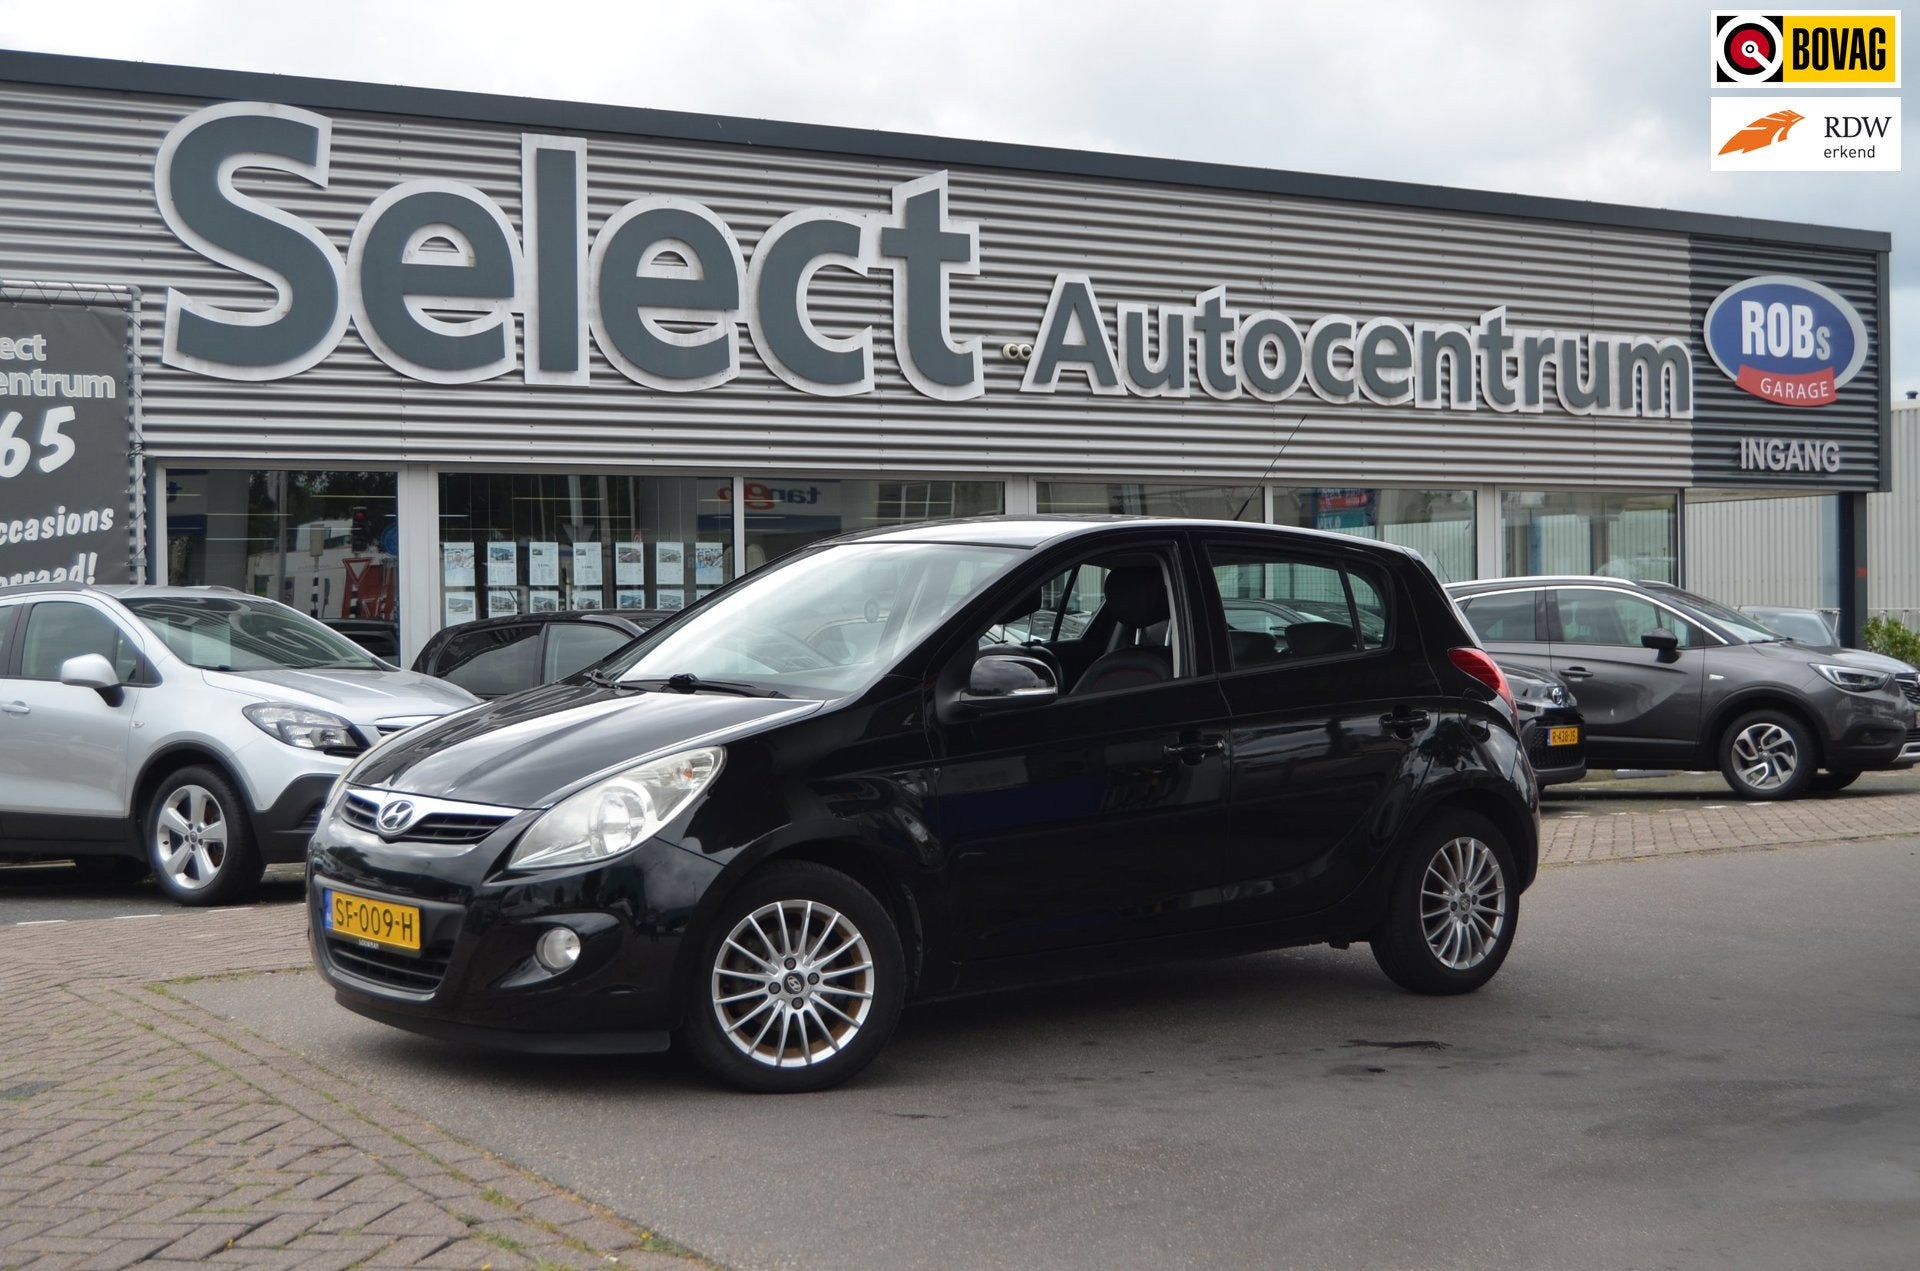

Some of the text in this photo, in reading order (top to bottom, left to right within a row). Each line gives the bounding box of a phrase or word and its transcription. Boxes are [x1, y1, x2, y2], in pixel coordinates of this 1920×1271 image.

[155, 101, 1695, 418] Select Autocentrum
[1741, 299, 1831, 361] ROBs
[1760, 377, 1830, 400] GARAGE
[1739, 436, 1840, 473] INGANG
[335, 898, 413, 942] SF-009-H
